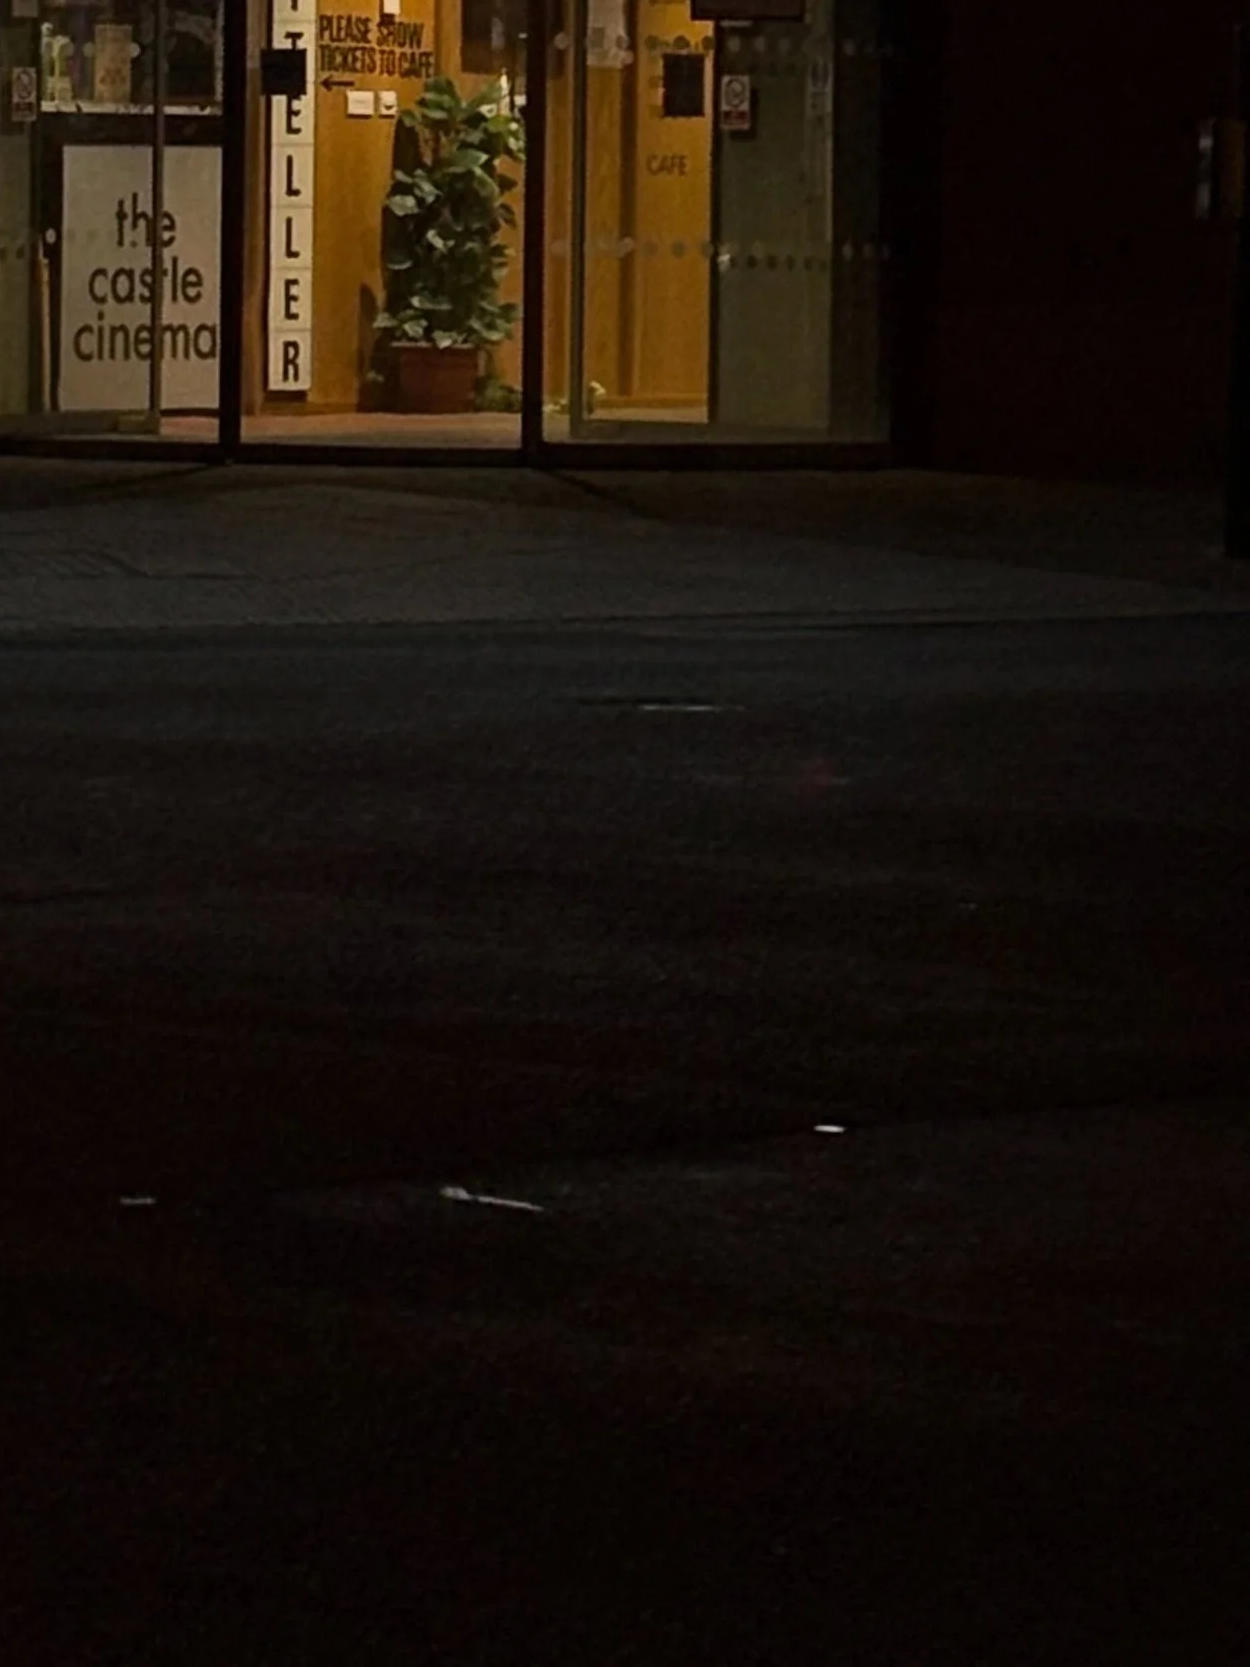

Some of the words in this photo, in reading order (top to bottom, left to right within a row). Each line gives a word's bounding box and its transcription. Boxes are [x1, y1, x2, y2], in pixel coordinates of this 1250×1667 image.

[319, 14, 372, 43] PLEASE
[376, 20, 425, 49] SHOW
[319, 44, 377, 74] TICKETS
[378, 49, 396, 77] TO
[115, 192, 176, 248] the
[73, 310, 217, 362] cinema
